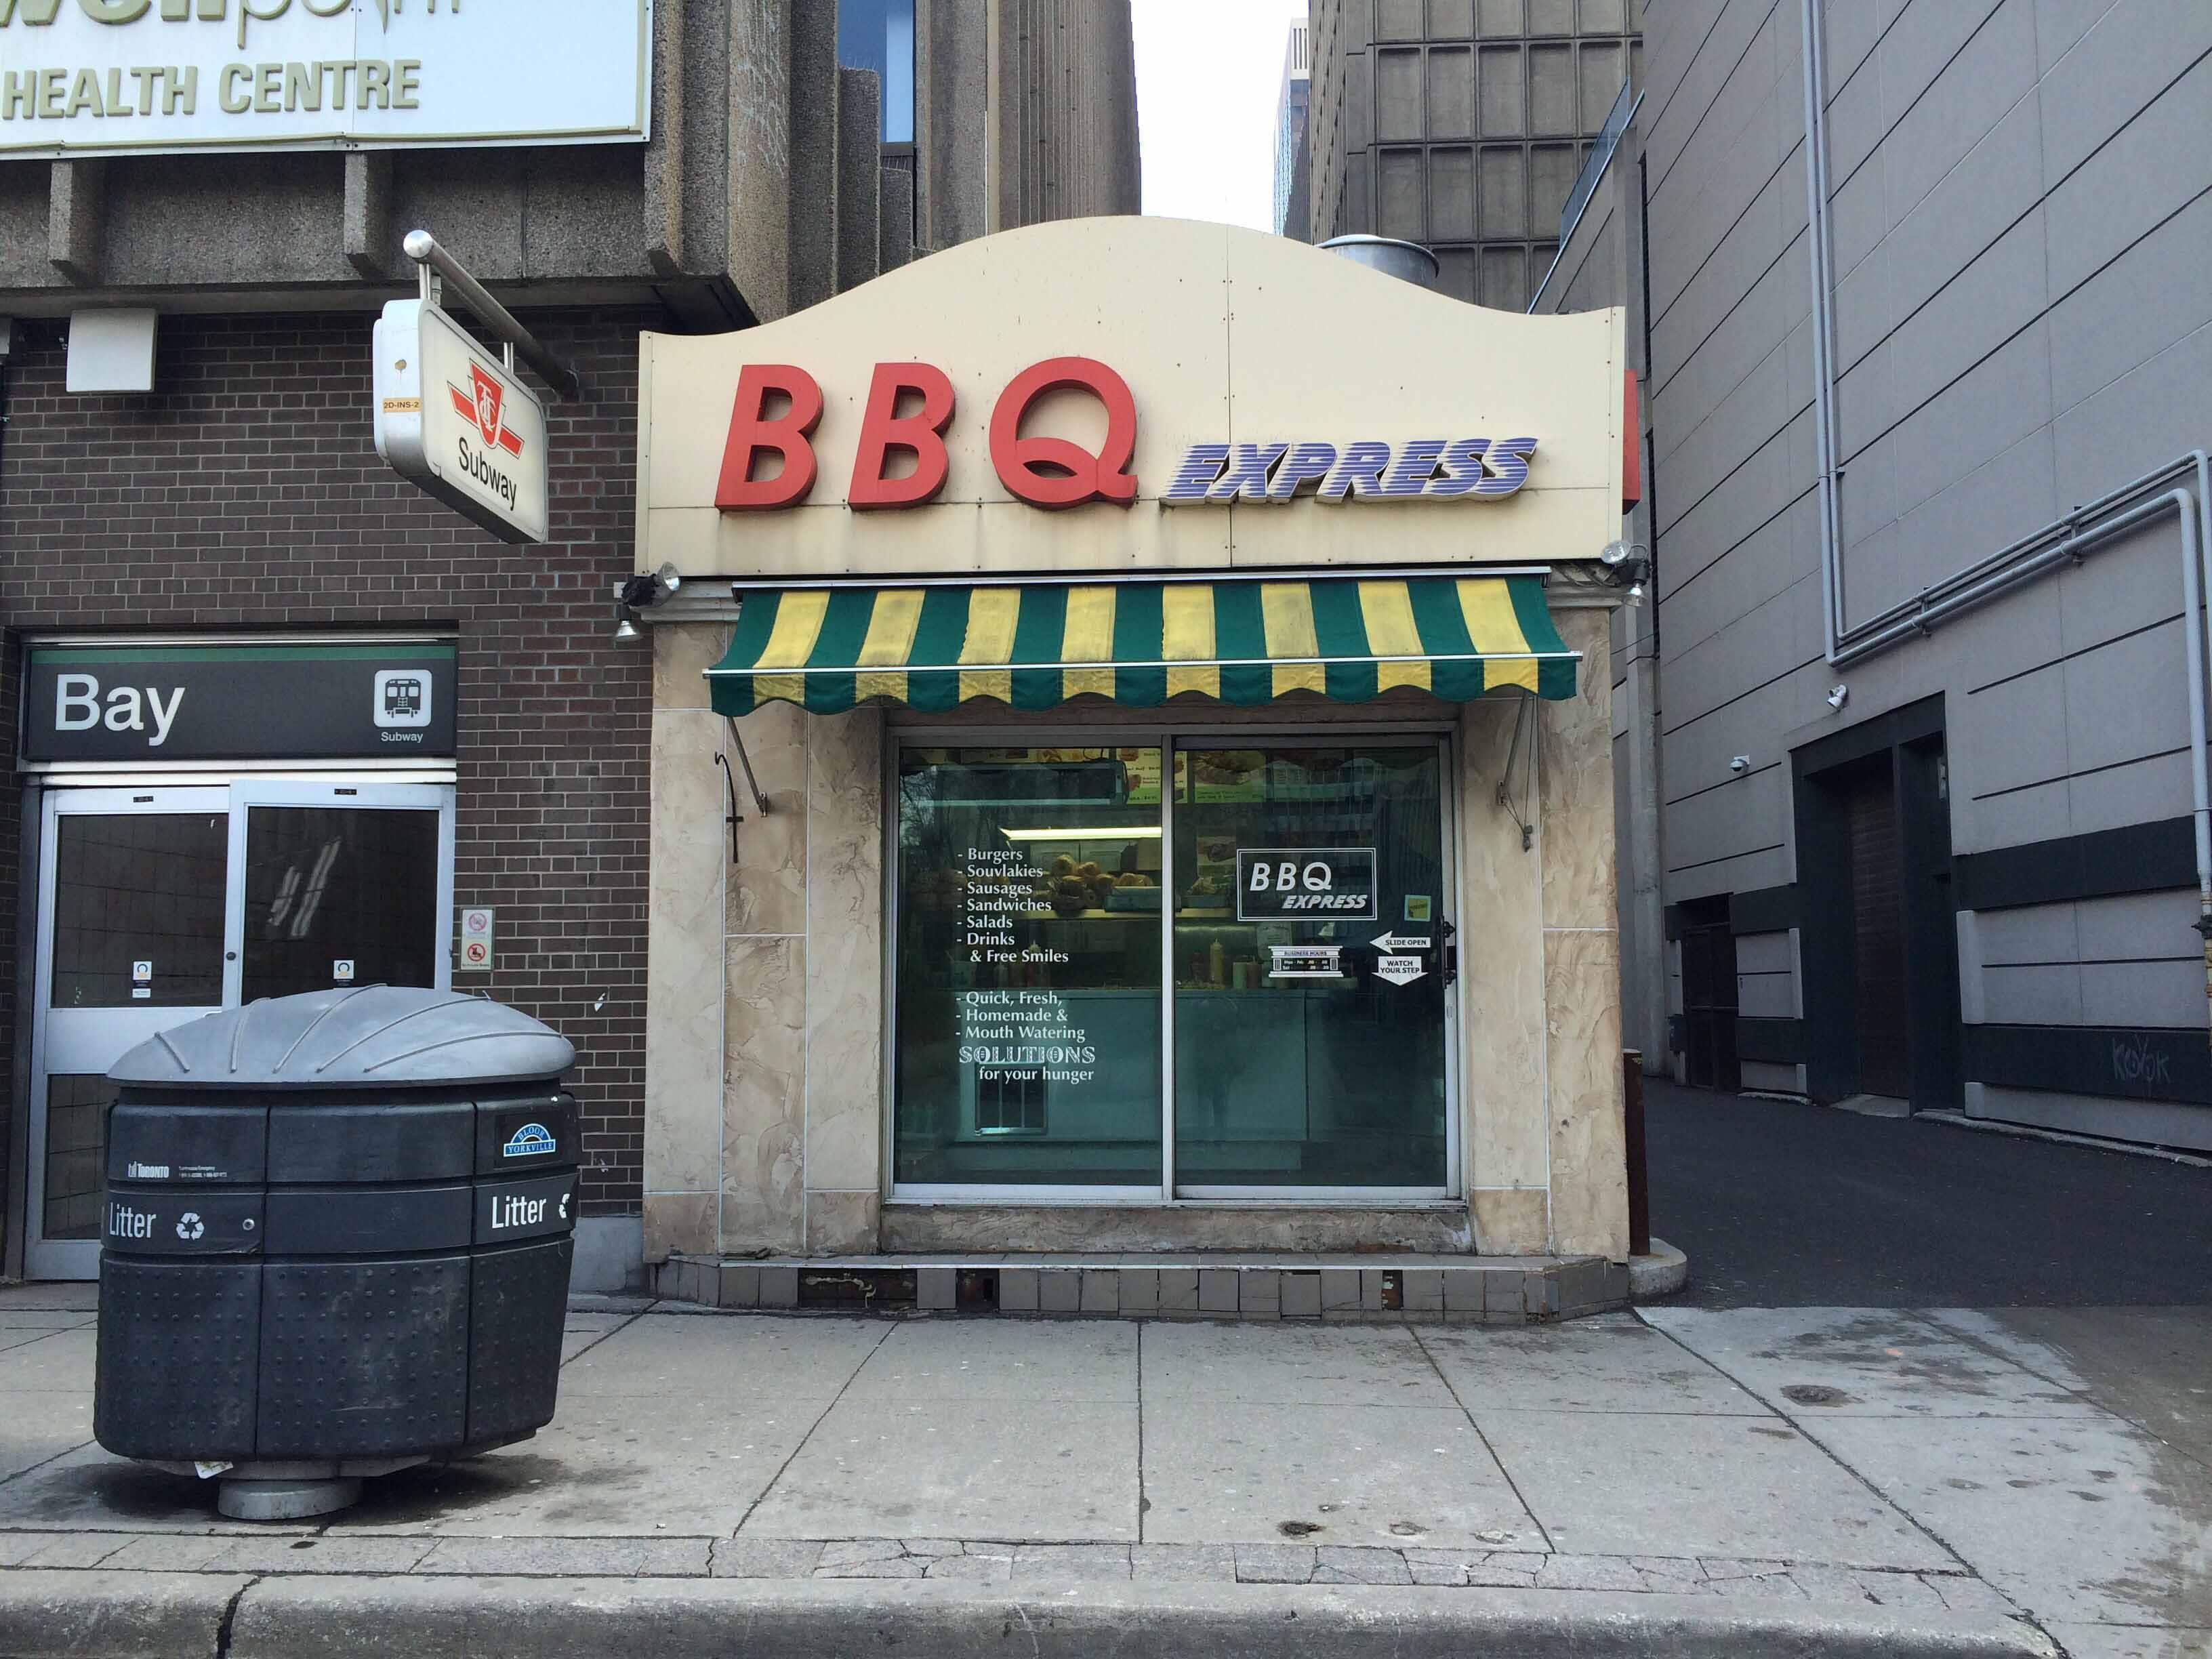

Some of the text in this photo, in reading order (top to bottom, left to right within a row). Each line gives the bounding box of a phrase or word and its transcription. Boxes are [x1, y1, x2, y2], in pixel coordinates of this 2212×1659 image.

[2, 59, 422, 120] HEALTH CENTRE
[714, 356, 1139, 511] BBQ
[458, 436, 517, 512] Subway
[1158, 436, 1539, 506] EXPRESS
[54, 674, 185, 746] Bay
[380, 731, 424, 743] Subway
[968, 848, 1023, 864] Burgers
[967, 864, 1043, 878] Souvlakies
[1249, 861, 1332, 892] BBQ
[967, 881, 1033, 898] Sausages
[967, 897, 1052, 912] Sandwiches
[1282, 894, 1368, 909] EXPRESS
[966, 915, 1013, 928] Salads
[967, 932, 1015, 945] Drinks
[970, 949, 1069, 962] & Free Smiles
[966, 991, 1063, 1007] Quick, Fresh,
[966, 1008, 1068, 1022] Homemade &
[965, 1025, 1086, 1044] Mouth Watering
[959, 1046, 1095, 1064] SOLUTIONS
[979, 1067, 1094, 1085] for your hunger
[517, 1126, 546, 1141] BLOOR
[508, 1141, 553, 1153] YORKVILLE
[109, 1202, 157, 1238] Litter
[492, 1195, 547, 1229] Litter
